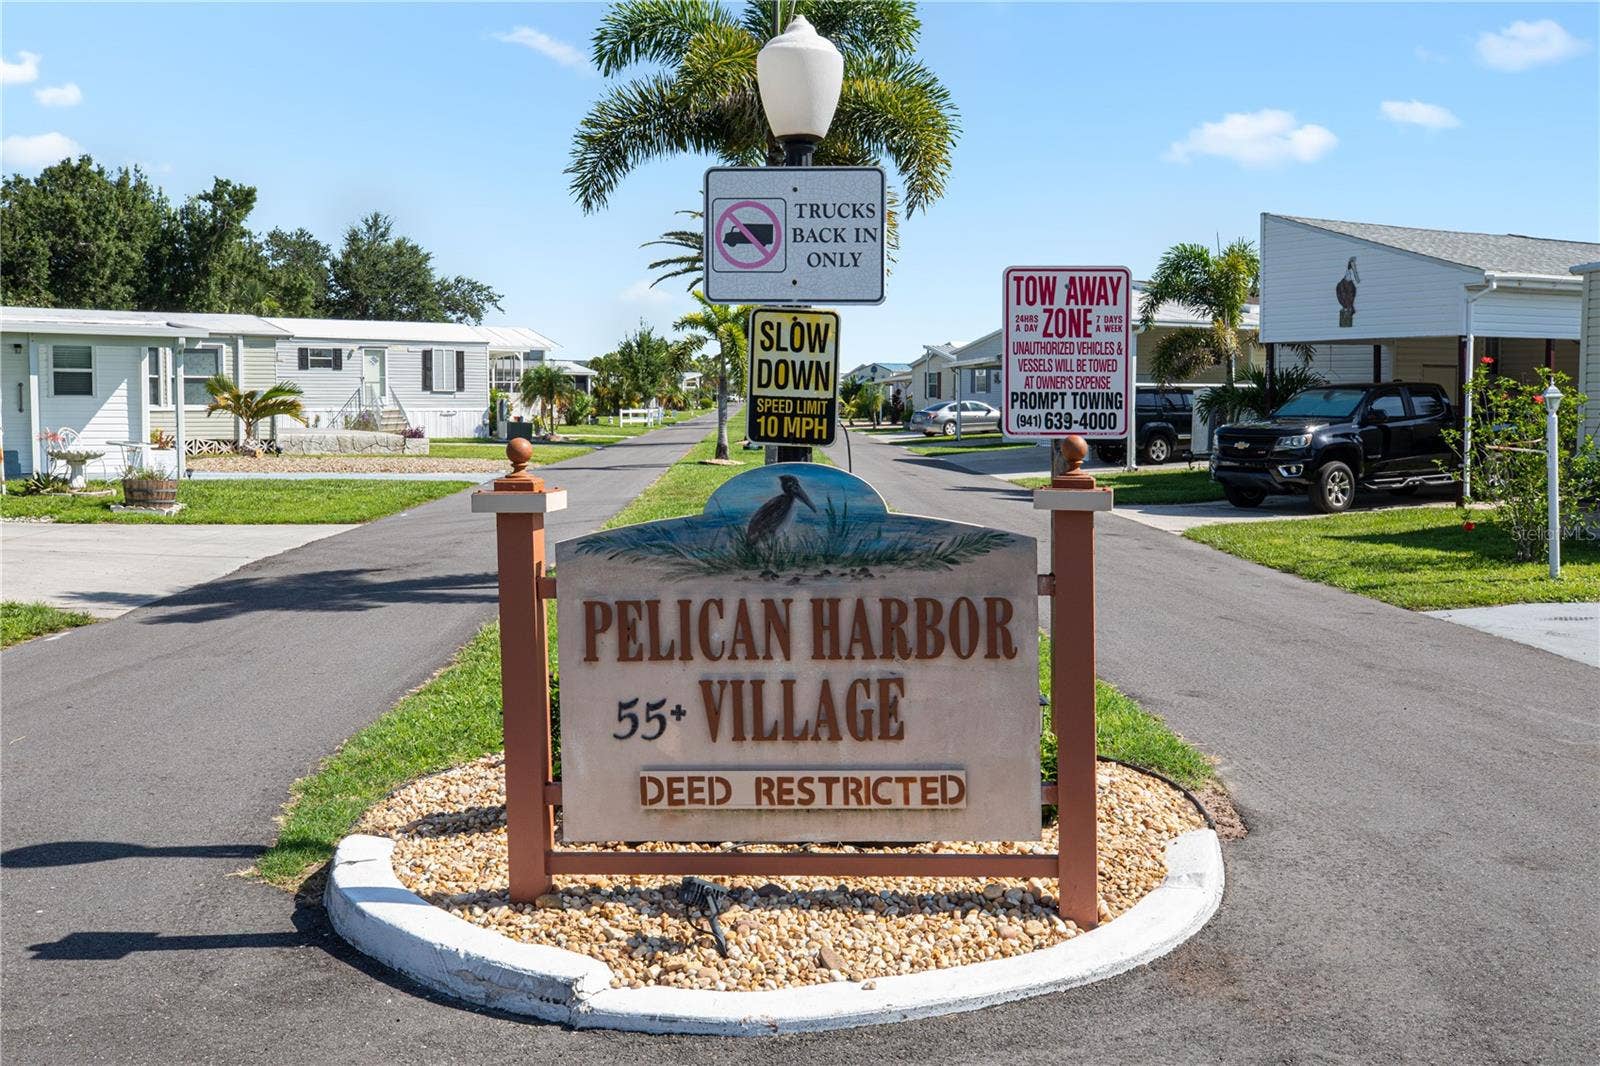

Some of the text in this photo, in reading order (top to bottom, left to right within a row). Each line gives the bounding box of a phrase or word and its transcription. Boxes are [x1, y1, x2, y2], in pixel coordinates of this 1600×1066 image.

[794, 203, 876, 219] TRUCKS
[792, 227, 878, 243] BACK IN
[806, 252, 863, 268] ONLY
[1013, 275, 1122, 307] TOW AWAY
[1015, 315, 1039, 323] 24HRS
[1042, 308, 1092, 338] ZONE
[1096, 315, 1123, 324] 7 DAYS
[760, 321, 830, 353] SLOW
[1015, 324, 1038, 333] A DAY
[1096, 325, 1123, 333] A WEEK
[1012, 341, 1123, 356] UNAUTHORIZED VEHICLES &
[757, 358, 830, 391] DOWN
[1018, 358, 1118, 373] VESSELS WILL BE TOWED
[1024, 375, 1111, 390] AT OWNER'S EXPENSE
[757, 398, 828, 415] SPEED LIMIT
[1011, 391, 1123, 410] PROMPT TOWING
[757, 415, 828, 439] 10 MPH
[1016, 411, 1117, 430] (941) 639-4000
[583, 596, 1019, 662] PELICAN HARBOR
[612, 697, 687, 741] 55+
[698, 678, 906, 743] VILLAGE
[640, 773, 966, 807] DEED RESTRICTED
